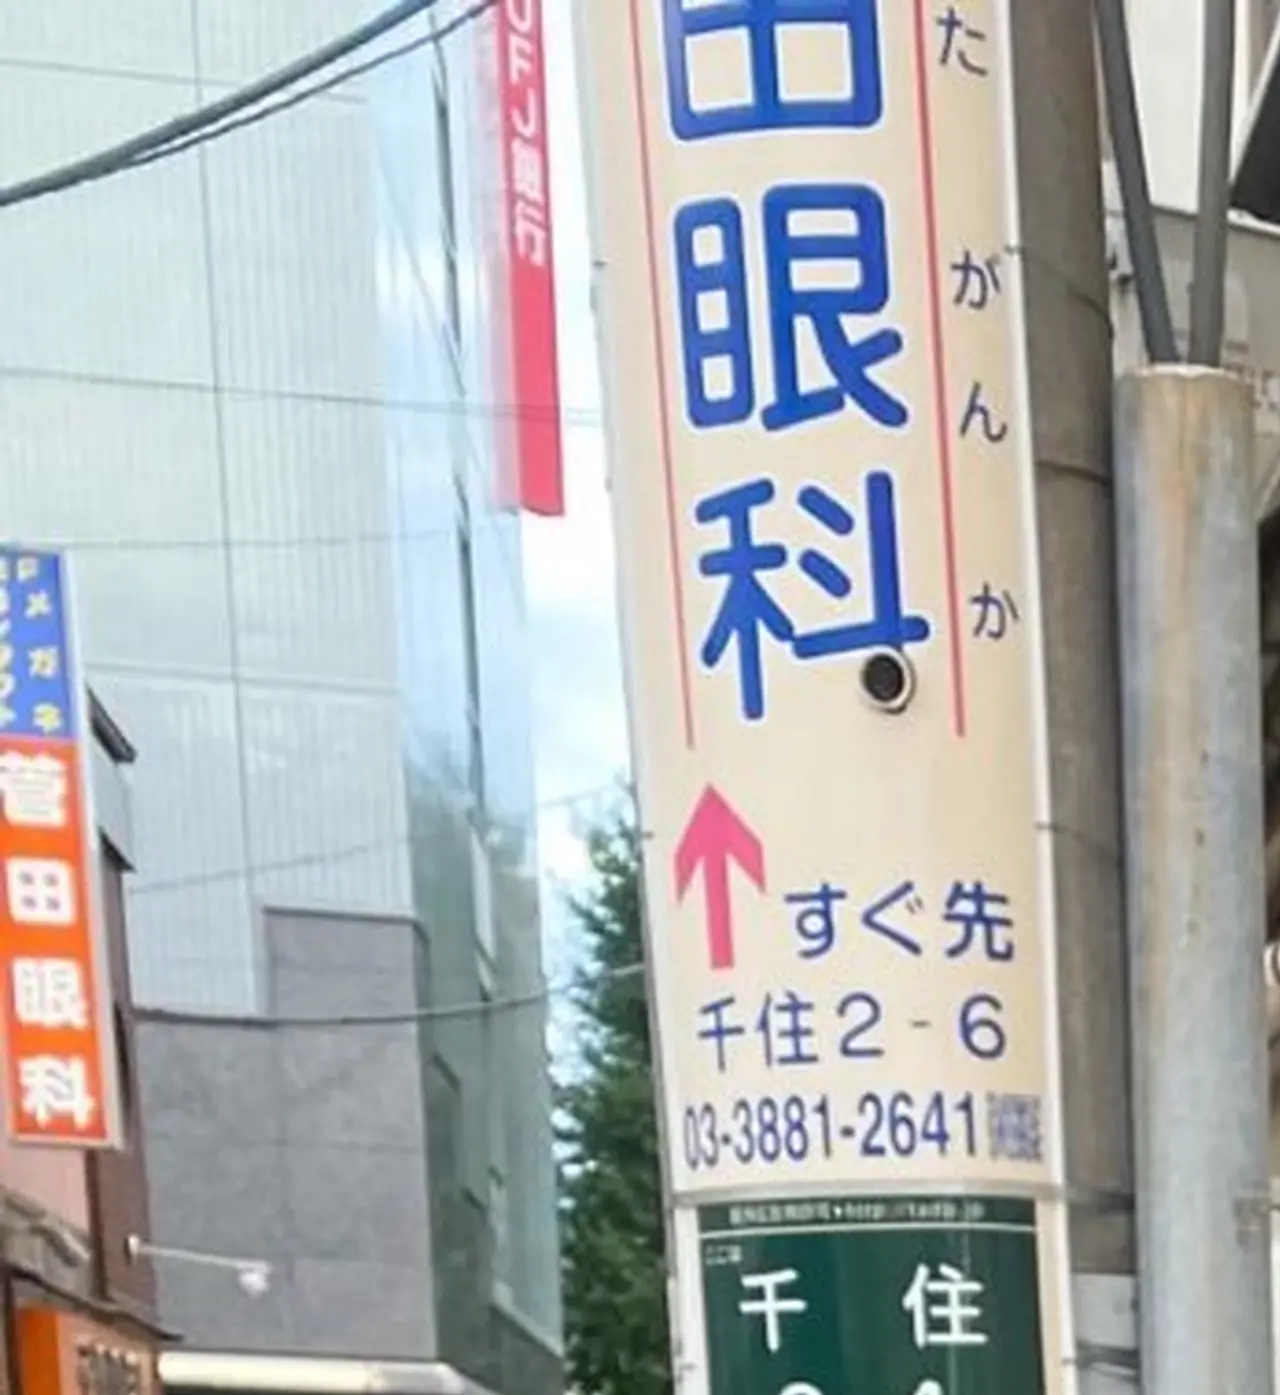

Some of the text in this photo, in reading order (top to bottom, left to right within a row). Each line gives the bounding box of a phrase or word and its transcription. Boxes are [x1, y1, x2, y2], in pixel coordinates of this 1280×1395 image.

[667, 0, 930, 719] 田眼科
[935, 7, 1019, 639] たがんか
[783, 880, 1014, 962] すぐ先
[684, 1092, 977, 1170] 03-3881-2641
[738, 1263, 989, 1352] 千住
